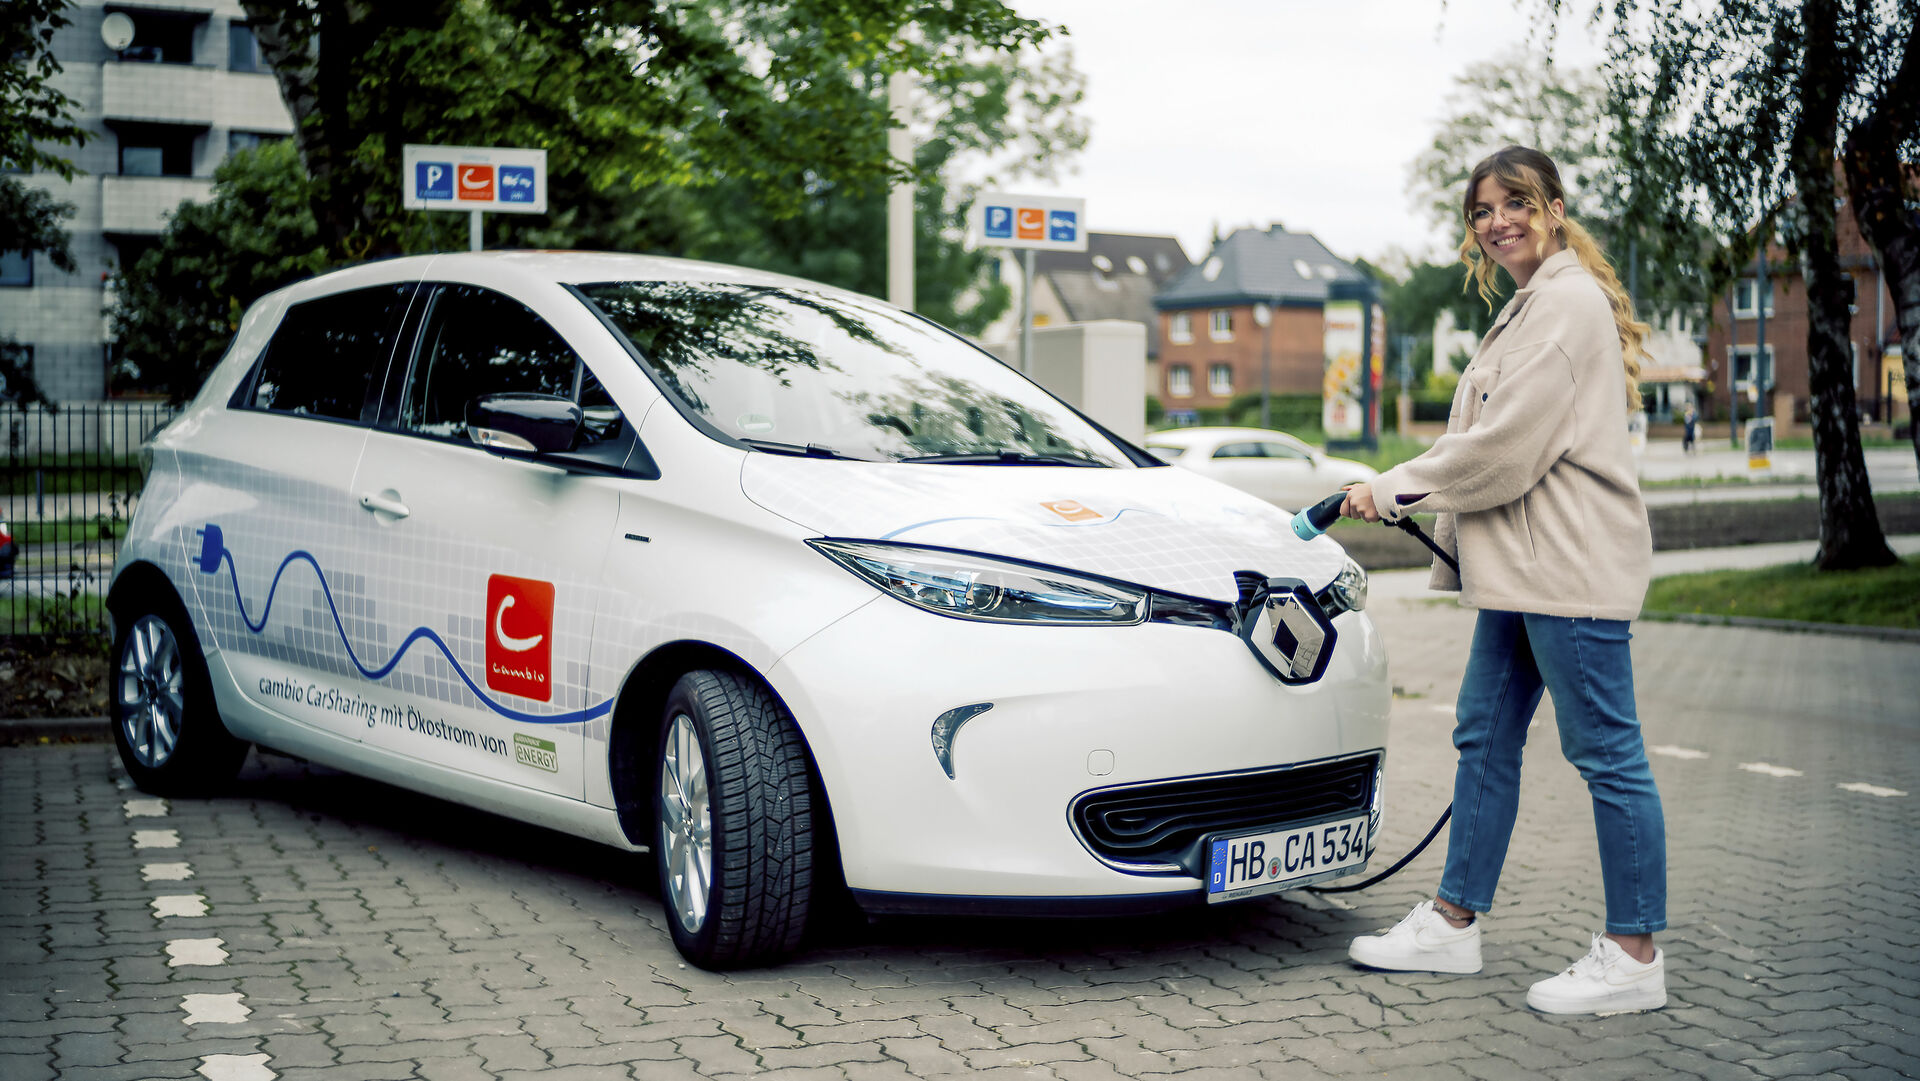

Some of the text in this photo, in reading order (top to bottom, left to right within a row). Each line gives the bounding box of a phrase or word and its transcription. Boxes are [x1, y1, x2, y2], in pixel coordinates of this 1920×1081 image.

[427, 165, 442, 189] P
[991, 208, 1007, 228] P
[492, 662, 544, 683] cambio
[259, 676, 303, 703] cambio
[306, 684, 377, 728] CarSharing
[381, 704, 404, 728] mit
[407, 704, 477, 748] Ökostrom
[479, 733, 508, 757] von
[1229, 821, 1364, 884] HB CA 534
[1213, 872, 1222, 885] D
